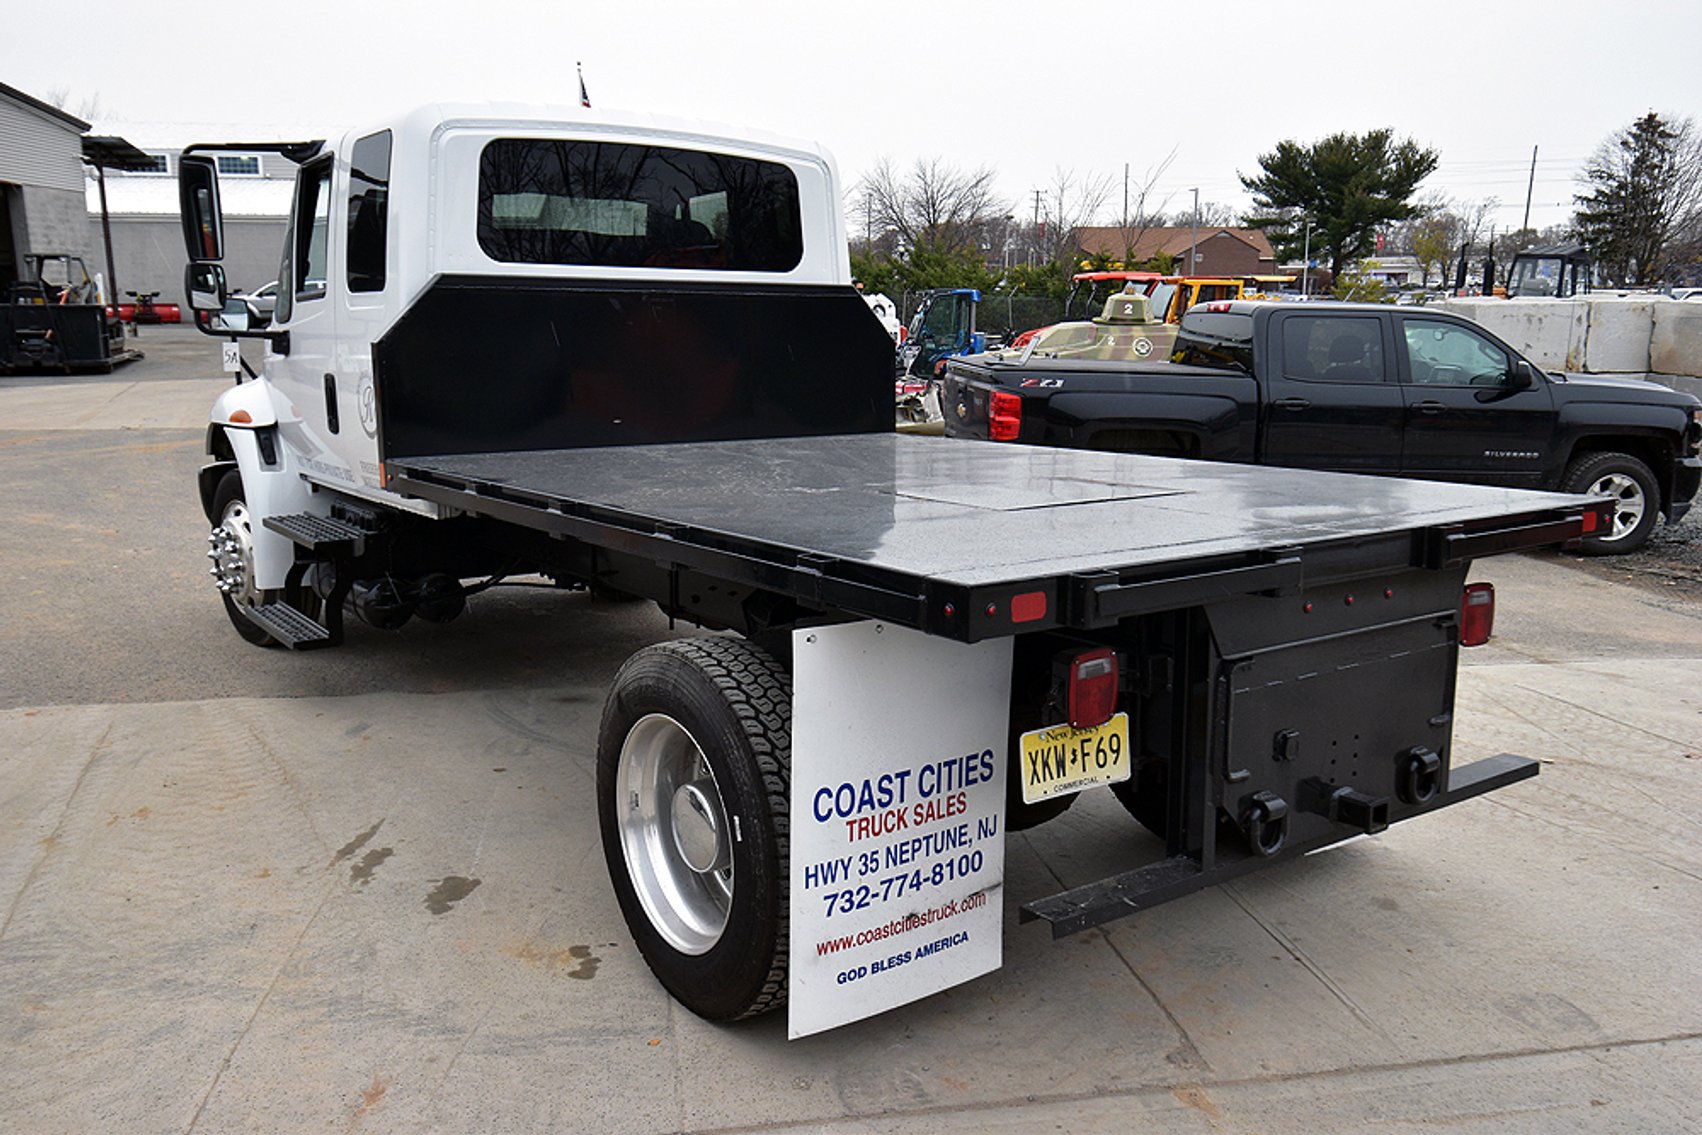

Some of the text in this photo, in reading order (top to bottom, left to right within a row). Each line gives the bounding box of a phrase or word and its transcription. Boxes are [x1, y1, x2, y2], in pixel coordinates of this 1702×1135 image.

[1028, 733, 1121, 786] XKW F69
[1046, 730, 1068, 742] New
[813, 749, 994, 823] COAST CITIES
[1053, 776, 1099, 793] COMMERCIAL
[846, 791, 968, 843] TRUCK SALES
[804, 814, 998, 890] HWY 35 NEPTUNE, NJ
[823, 850, 983, 918] 732-774-8100
[816, 892, 987, 957] www.coastcitiestruck.com
[836, 930, 969, 985] GOD BLESS AMERICA
